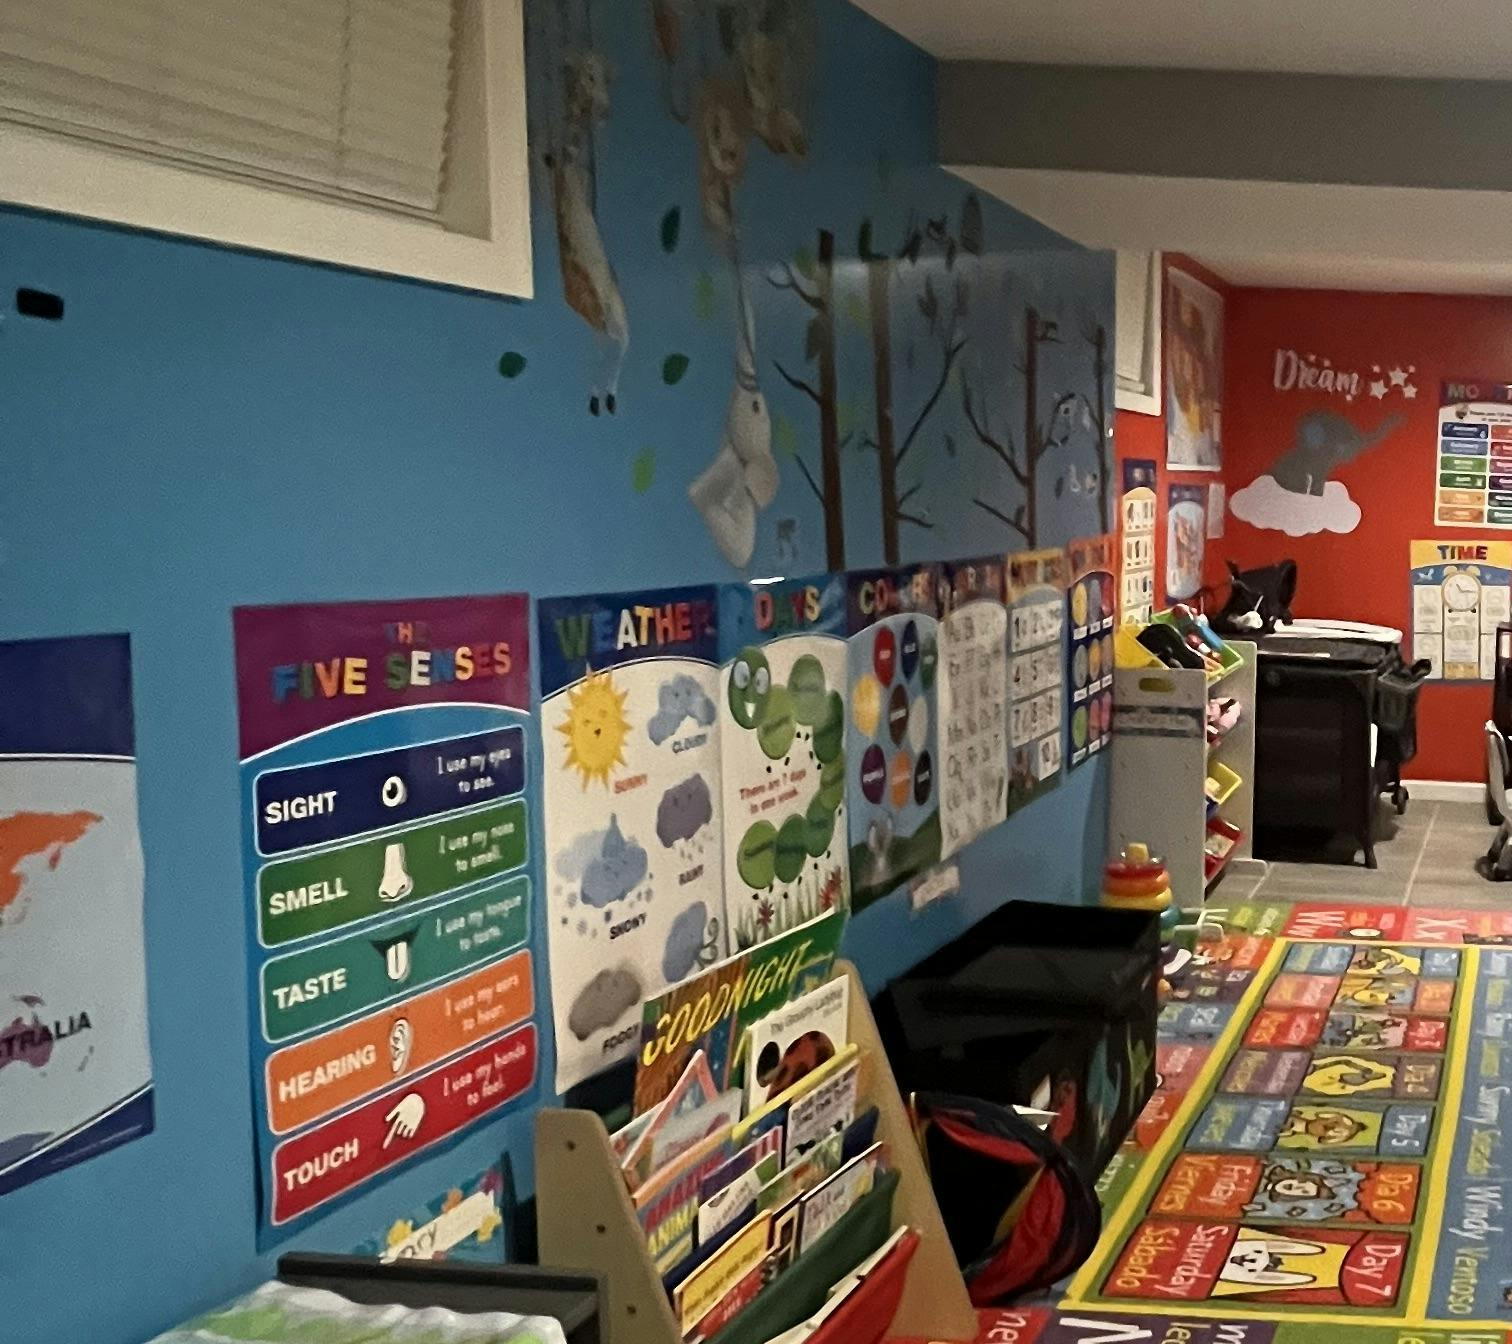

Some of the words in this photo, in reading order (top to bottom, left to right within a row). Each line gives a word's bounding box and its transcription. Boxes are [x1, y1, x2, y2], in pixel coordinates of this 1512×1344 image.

[1274, 348, 1358, 394] Dream
[1437, 545, 1488, 560] TIME
[555, 597, 716, 661] WEATHER
[272, 658, 367, 704] FIVE
[386, 642, 512, 690] SENSES
[447, 758, 467, 774] use
[470, 754, 486, 772] my
[488, 747, 511, 769] eyes
[264, 790, 337, 824] SIGHT
[448, 834, 468, 850] use
[472, 829, 488, 846] my
[269, 878, 349, 915] SMELL
[445, 917, 466, 933] use
[468, 911, 484, 927] my
[610, 913, 646, 940] SNOWY
[273, 968, 347, 1010] TASTE
[454, 995, 475, 1012] use
[476, 989, 494, 1007] my
[643, 939, 813, 1067] GOODNIGHT
[603, 1021, 640, 1054] FOGGY
[279, 1045, 377, 1103] HEARING
[453, 1072, 473, 1091] use
[475, 1064, 492, 1083] my
[494, 1044, 527, 1067] hands
[1393, 1114, 1428, 1138] Day
[1464, 1084, 1511, 1127] Sunny
[282, 1138, 361, 1192] TOUCH
[1160, 1155, 1213, 1212] Viernes
[1202, 1162, 1253, 1207] Friday
[1375, 1171, 1413, 1197] Día
[1375, 1198, 1406, 1212] 6
[1448, 1184, 1503, 1241] Windy
[1115, 1225, 1181, 1290] Sábado
[1160, 1224, 1229, 1298] Saturday
[1355, 1244, 1401, 1279] Day
[1369, 1277, 1395, 1298] 7
[1447, 1242, 1490, 1316] Ventoso
